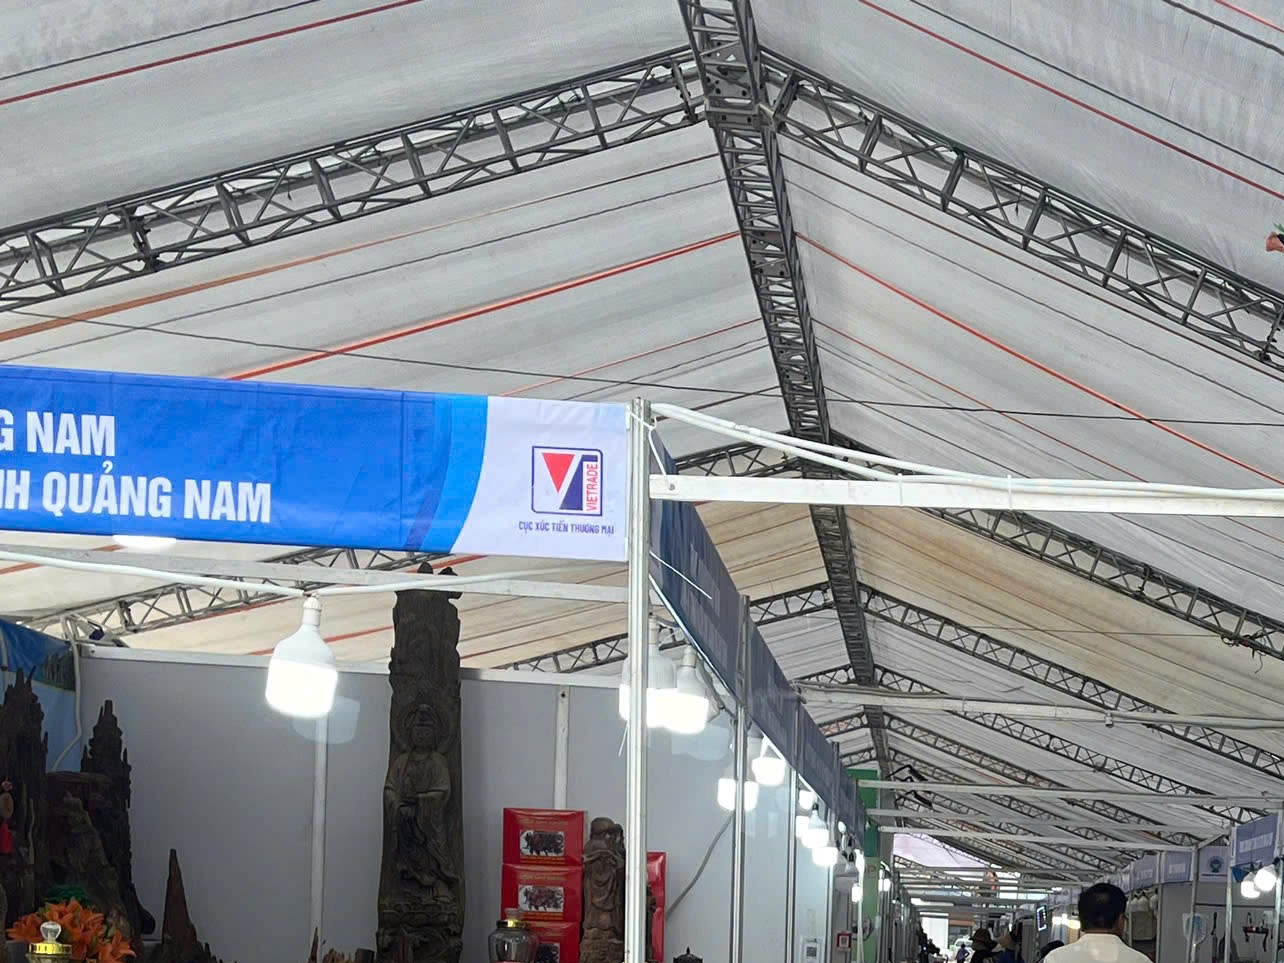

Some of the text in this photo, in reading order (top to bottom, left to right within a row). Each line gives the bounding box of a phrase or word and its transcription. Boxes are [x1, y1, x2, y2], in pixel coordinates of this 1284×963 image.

[27, 411, 116, 457] NAM
[42, 460, 173, 517] QUẢNG
[183, 478, 272, 523] NAM
[586, 463, 598, 511] VIETRADE
